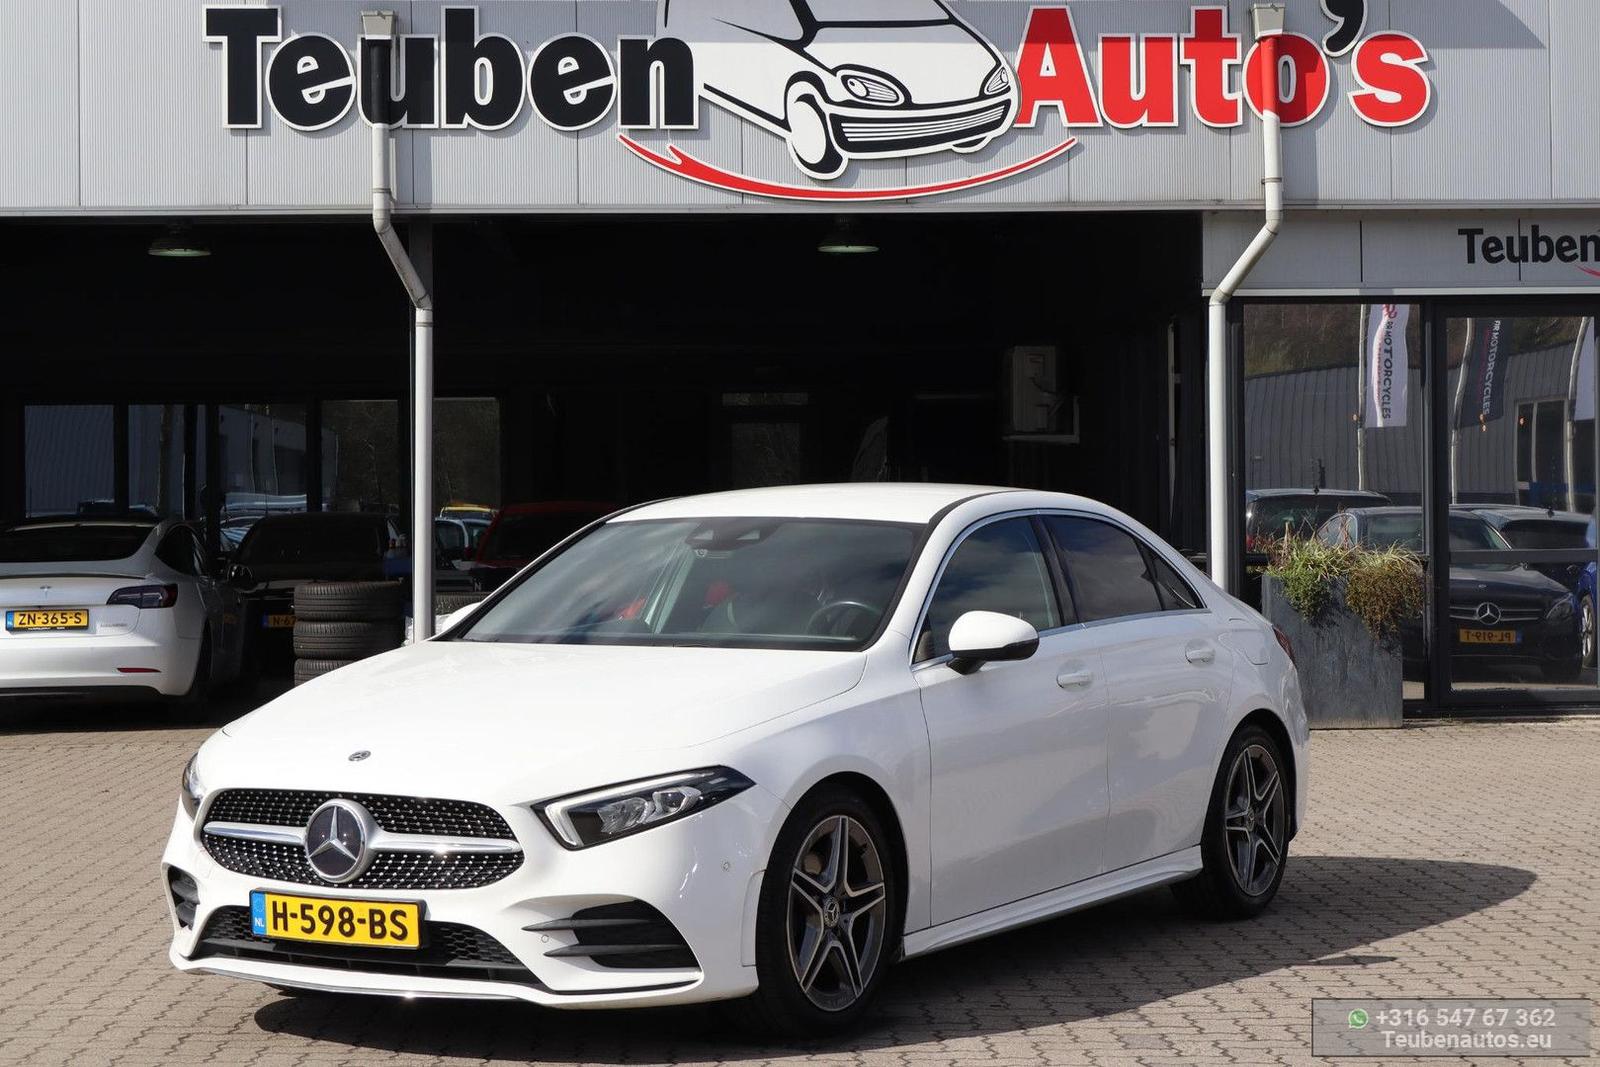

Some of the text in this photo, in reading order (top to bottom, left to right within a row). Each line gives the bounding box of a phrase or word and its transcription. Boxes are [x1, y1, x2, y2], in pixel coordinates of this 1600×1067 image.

[203, 0, 1435, 131] Teuben Auto's
[1458, 224, 1600, 264] Teuben
[1382, 331, 1392, 419] MOTORCYCLES
[1483, 332, 1500, 415] MOTORCYCLES
[18, 612, 82, 625] ZN-365-S
[254, 917, 265, 928] NL
[272, 900, 409, 941] H-598-BS
